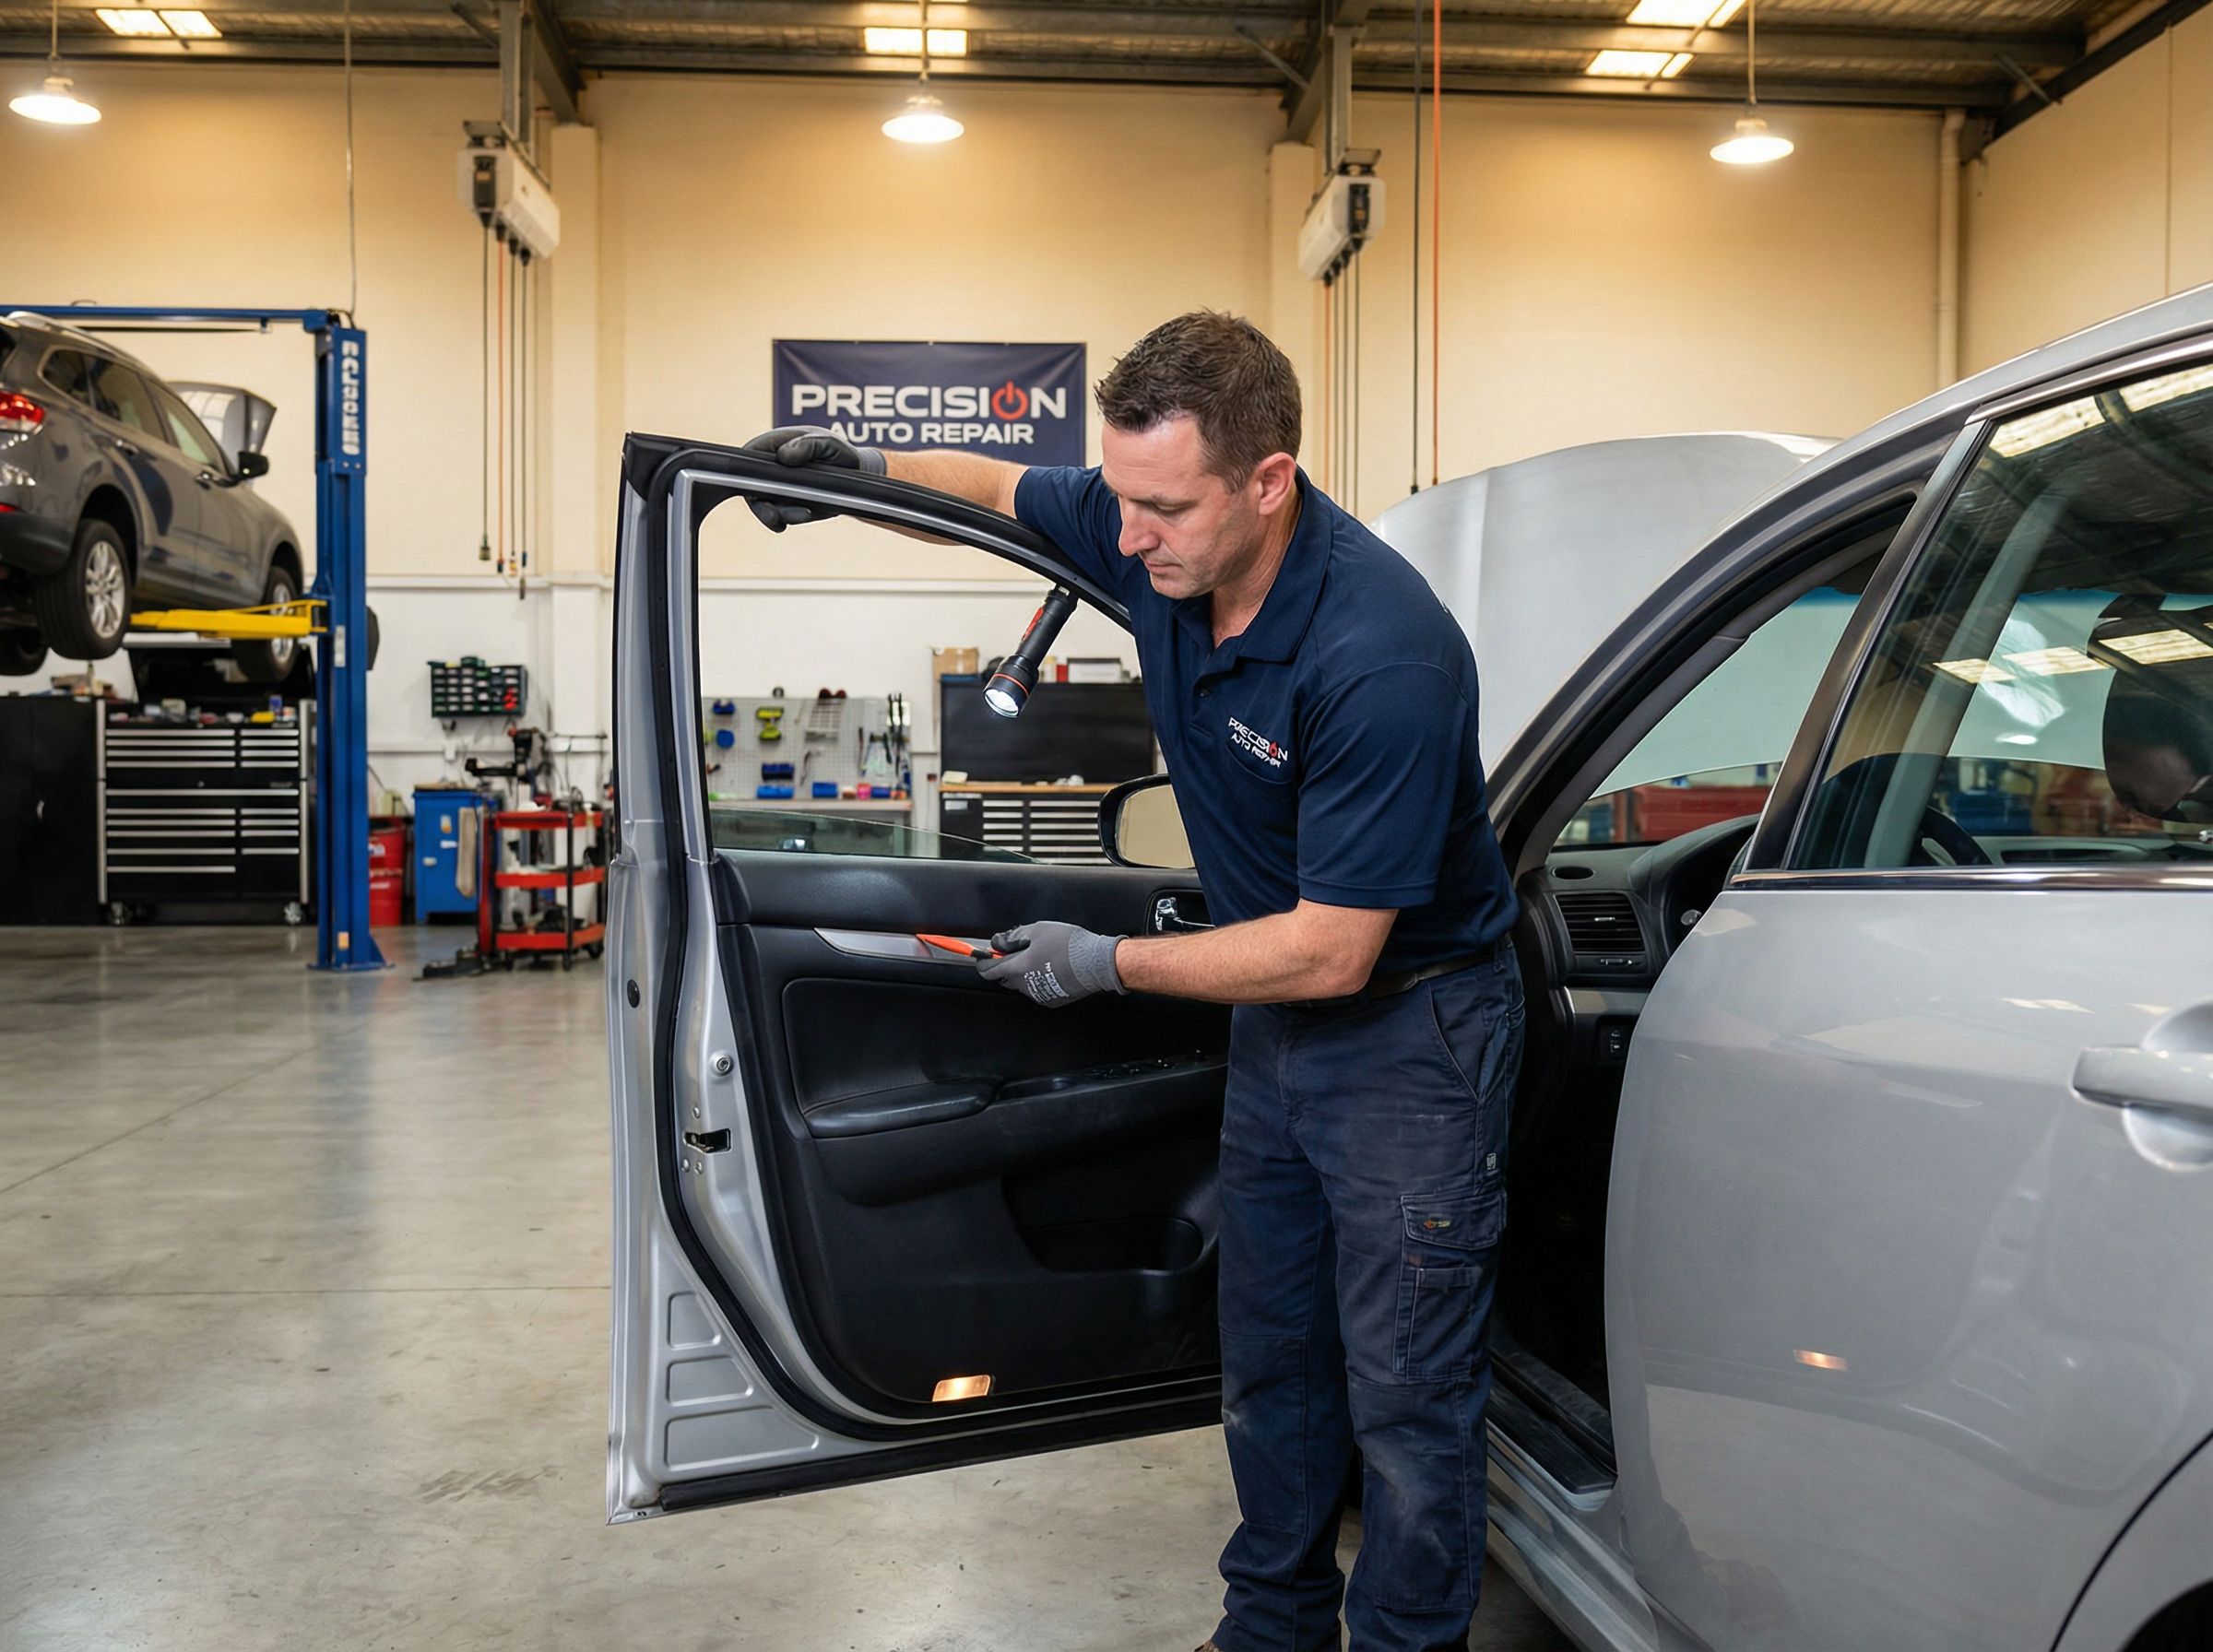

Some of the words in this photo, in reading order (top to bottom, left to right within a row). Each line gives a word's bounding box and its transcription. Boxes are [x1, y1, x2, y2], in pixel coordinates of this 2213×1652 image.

[791, 381, 1067, 420] PRECISION
[830, 421, 914, 443] AUTO
[920, 422, 1035, 444] REPAIR
